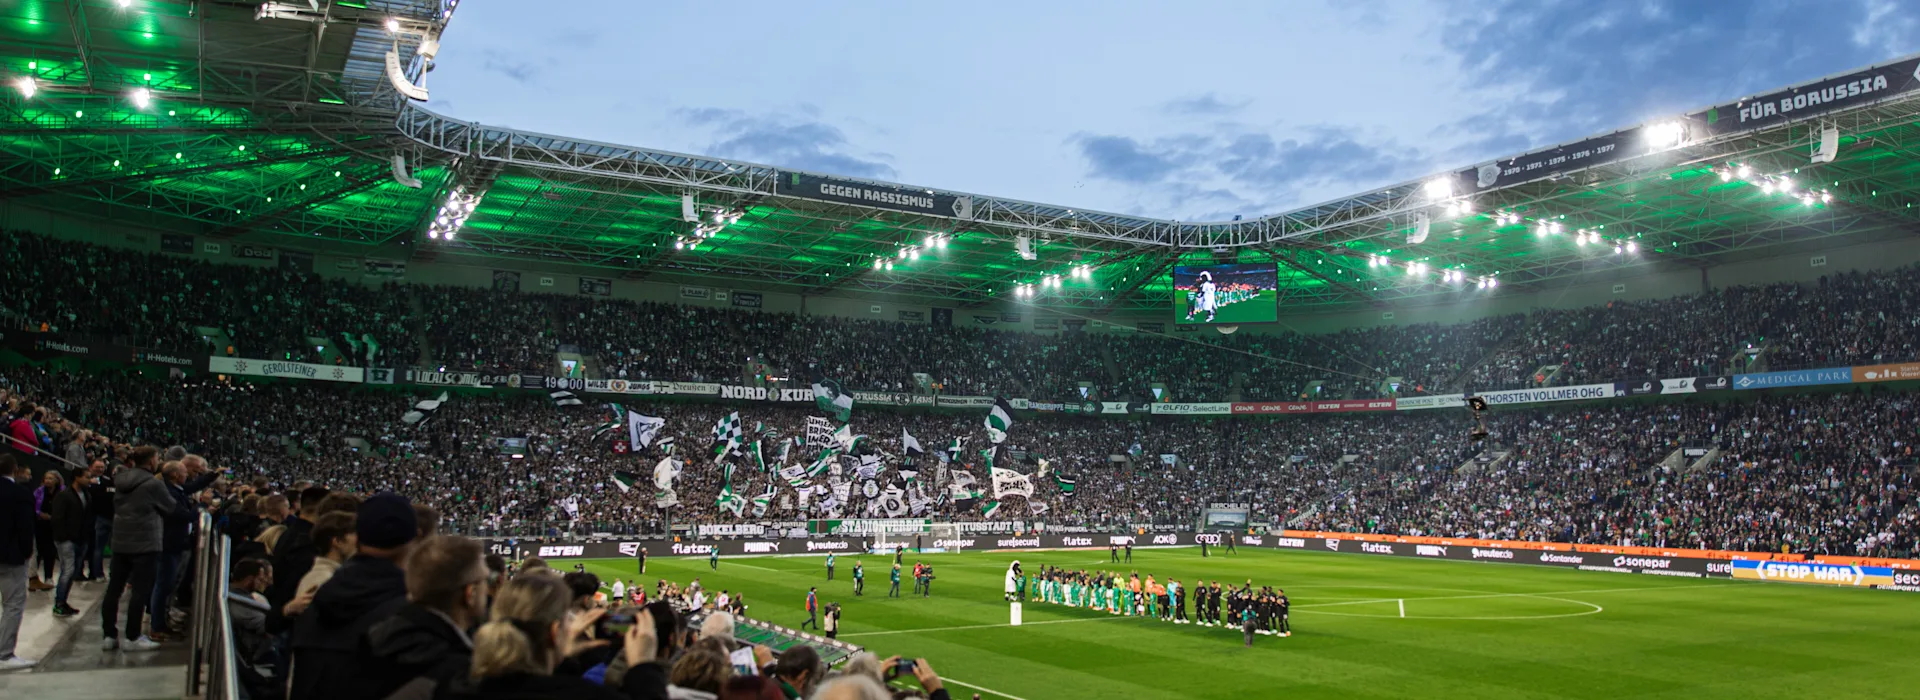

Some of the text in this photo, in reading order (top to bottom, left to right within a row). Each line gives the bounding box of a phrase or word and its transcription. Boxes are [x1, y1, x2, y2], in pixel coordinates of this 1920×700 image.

[1739, 75, 1888, 123] FÜR BORUSSIA
[1504, 143, 1615, 176] 1970 1971 1975 1976 1977
[820, 183, 934, 209] GEGEN RASSISMUS
[147, 353, 192, 367] H-Hotels.com
[262, 363, 318, 379] GEROLSTEINER
[545, 376, 558, 389] 19
[1757, 371, 1850, 385] MEDICAL PARK
[588, 382, 608, 390] WILDE
[721, 385, 815, 402] NORD KUR
[1485, 386, 1603, 403] THORSTEN VOLLMER OHG
[1193, 405, 1229, 413] SelectLine
[698, 523, 764, 535] BÖKELBERG
[842, 519, 926, 533] STADIONVERBOT
[957, 521, 1013, 532] ITUSSTADT
[998, 536, 1040, 548] sure[secure]
[1063, 536, 1092, 546] flatex
[1153, 535, 1168, 544] AOK
[1278, 538, 1305, 547] ELTEN
[490, 544, 512, 555] fla
[538, 545, 584, 557] ELTEN
[672, 543, 713, 554] flatex
[744, 542, 771, 552] PUMA
[814, 541, 849, 550] reuter.de
[1361, 542, 1392, 553] flatex
[1416, 545, 1440, 555] PUMA
[1479, 549, 1514, 559] reuter.de
[1548, 554, 1583, 564] Santander
[1626, 559, 1671, 570] sonepar
[1767, 563, 1853, 582] STOP WAR
